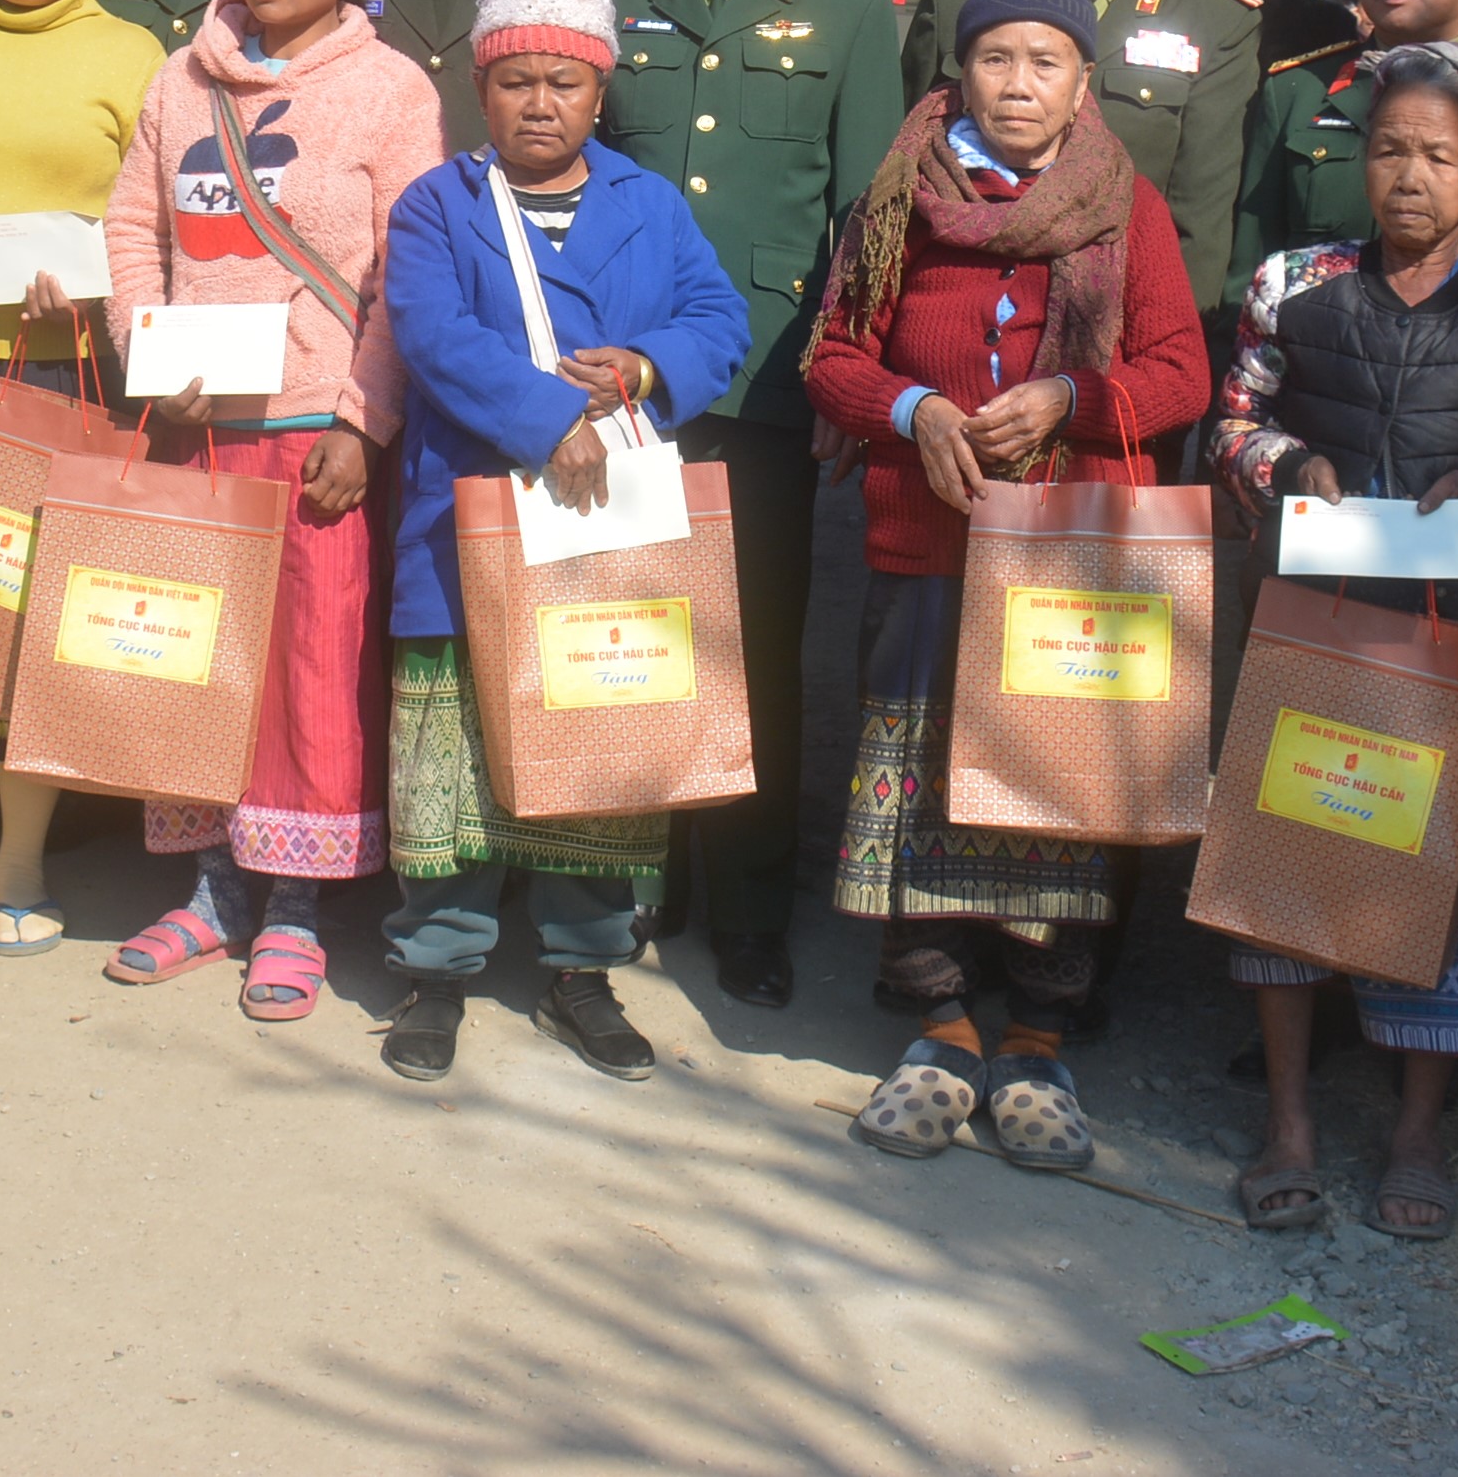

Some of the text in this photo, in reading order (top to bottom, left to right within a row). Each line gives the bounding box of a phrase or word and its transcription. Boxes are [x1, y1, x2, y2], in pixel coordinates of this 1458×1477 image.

[126, 583, 147, 593] NHÂN
[148, 586, 164, 596] DÂN
[165, 589, 180, 599] VIỆT
[182, 592, 200, 601] NAM
[1070, 600, 1092, 609] NHÂN
[1095, 601, 1111, 610] DÂN
[1113, 602, 1129, 612] VIỆT
[142, 623, 165, 635] HẬU
[1094, 641, 1118, 655] HẬU
[1337, 733, 1360, 745] NHÂN
[1361, 739, 1378, 750] DÂN
[1380, 744, 1397, 755] VIỆT
[1398, 749, 1418, 761] NAM
[1352, 779, 1377, 794] HẬU
